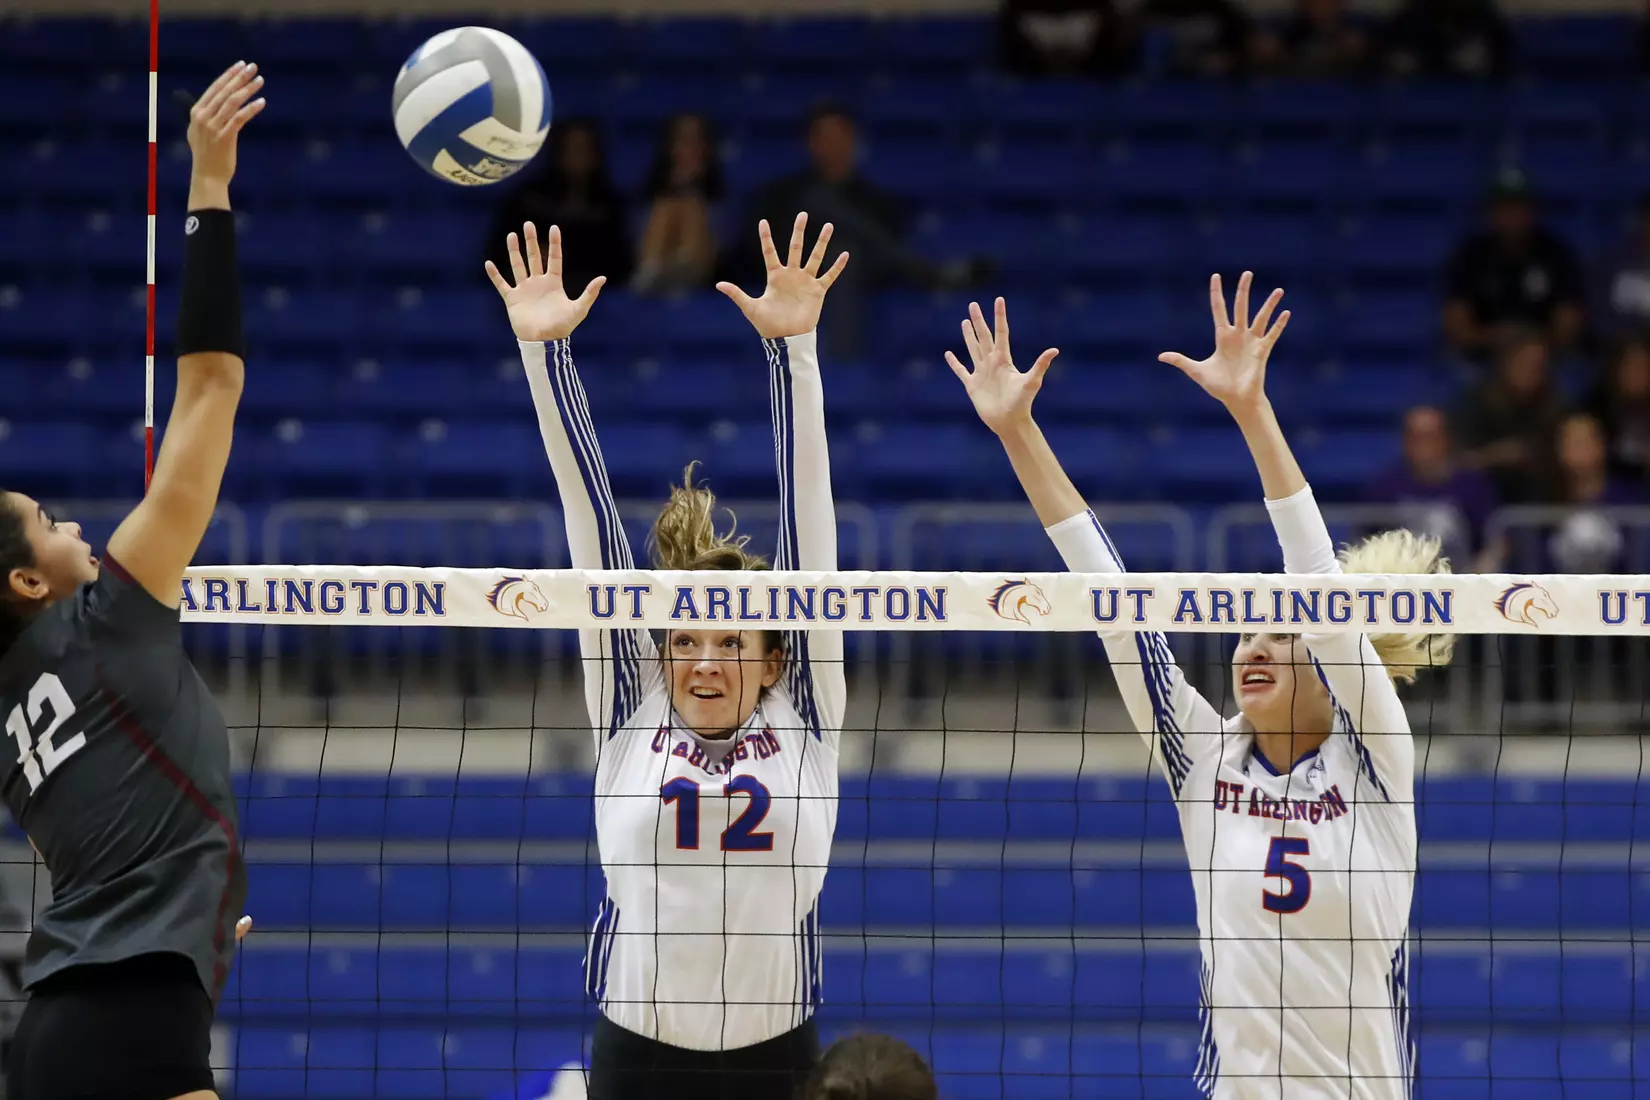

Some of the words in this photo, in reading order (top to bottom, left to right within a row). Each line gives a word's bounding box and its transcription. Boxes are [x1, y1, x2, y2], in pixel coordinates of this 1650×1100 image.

[181, 577, 447, 617] ARLINGTON
[586, 584, 652, 621] UT
[669, 585, 948, 622] ARLINGTON
[1089, 587, 1155, 623] UT
[1172, 588, 1454, 625] ARLINGTON
[1598, 590, 1650, 626] UT
[5, 672, 87, 796] 12
[659, 776, 774, 851] 12
[1215, 779, 1244, 814] UT
[1262, 836, 1312, 914] 5
